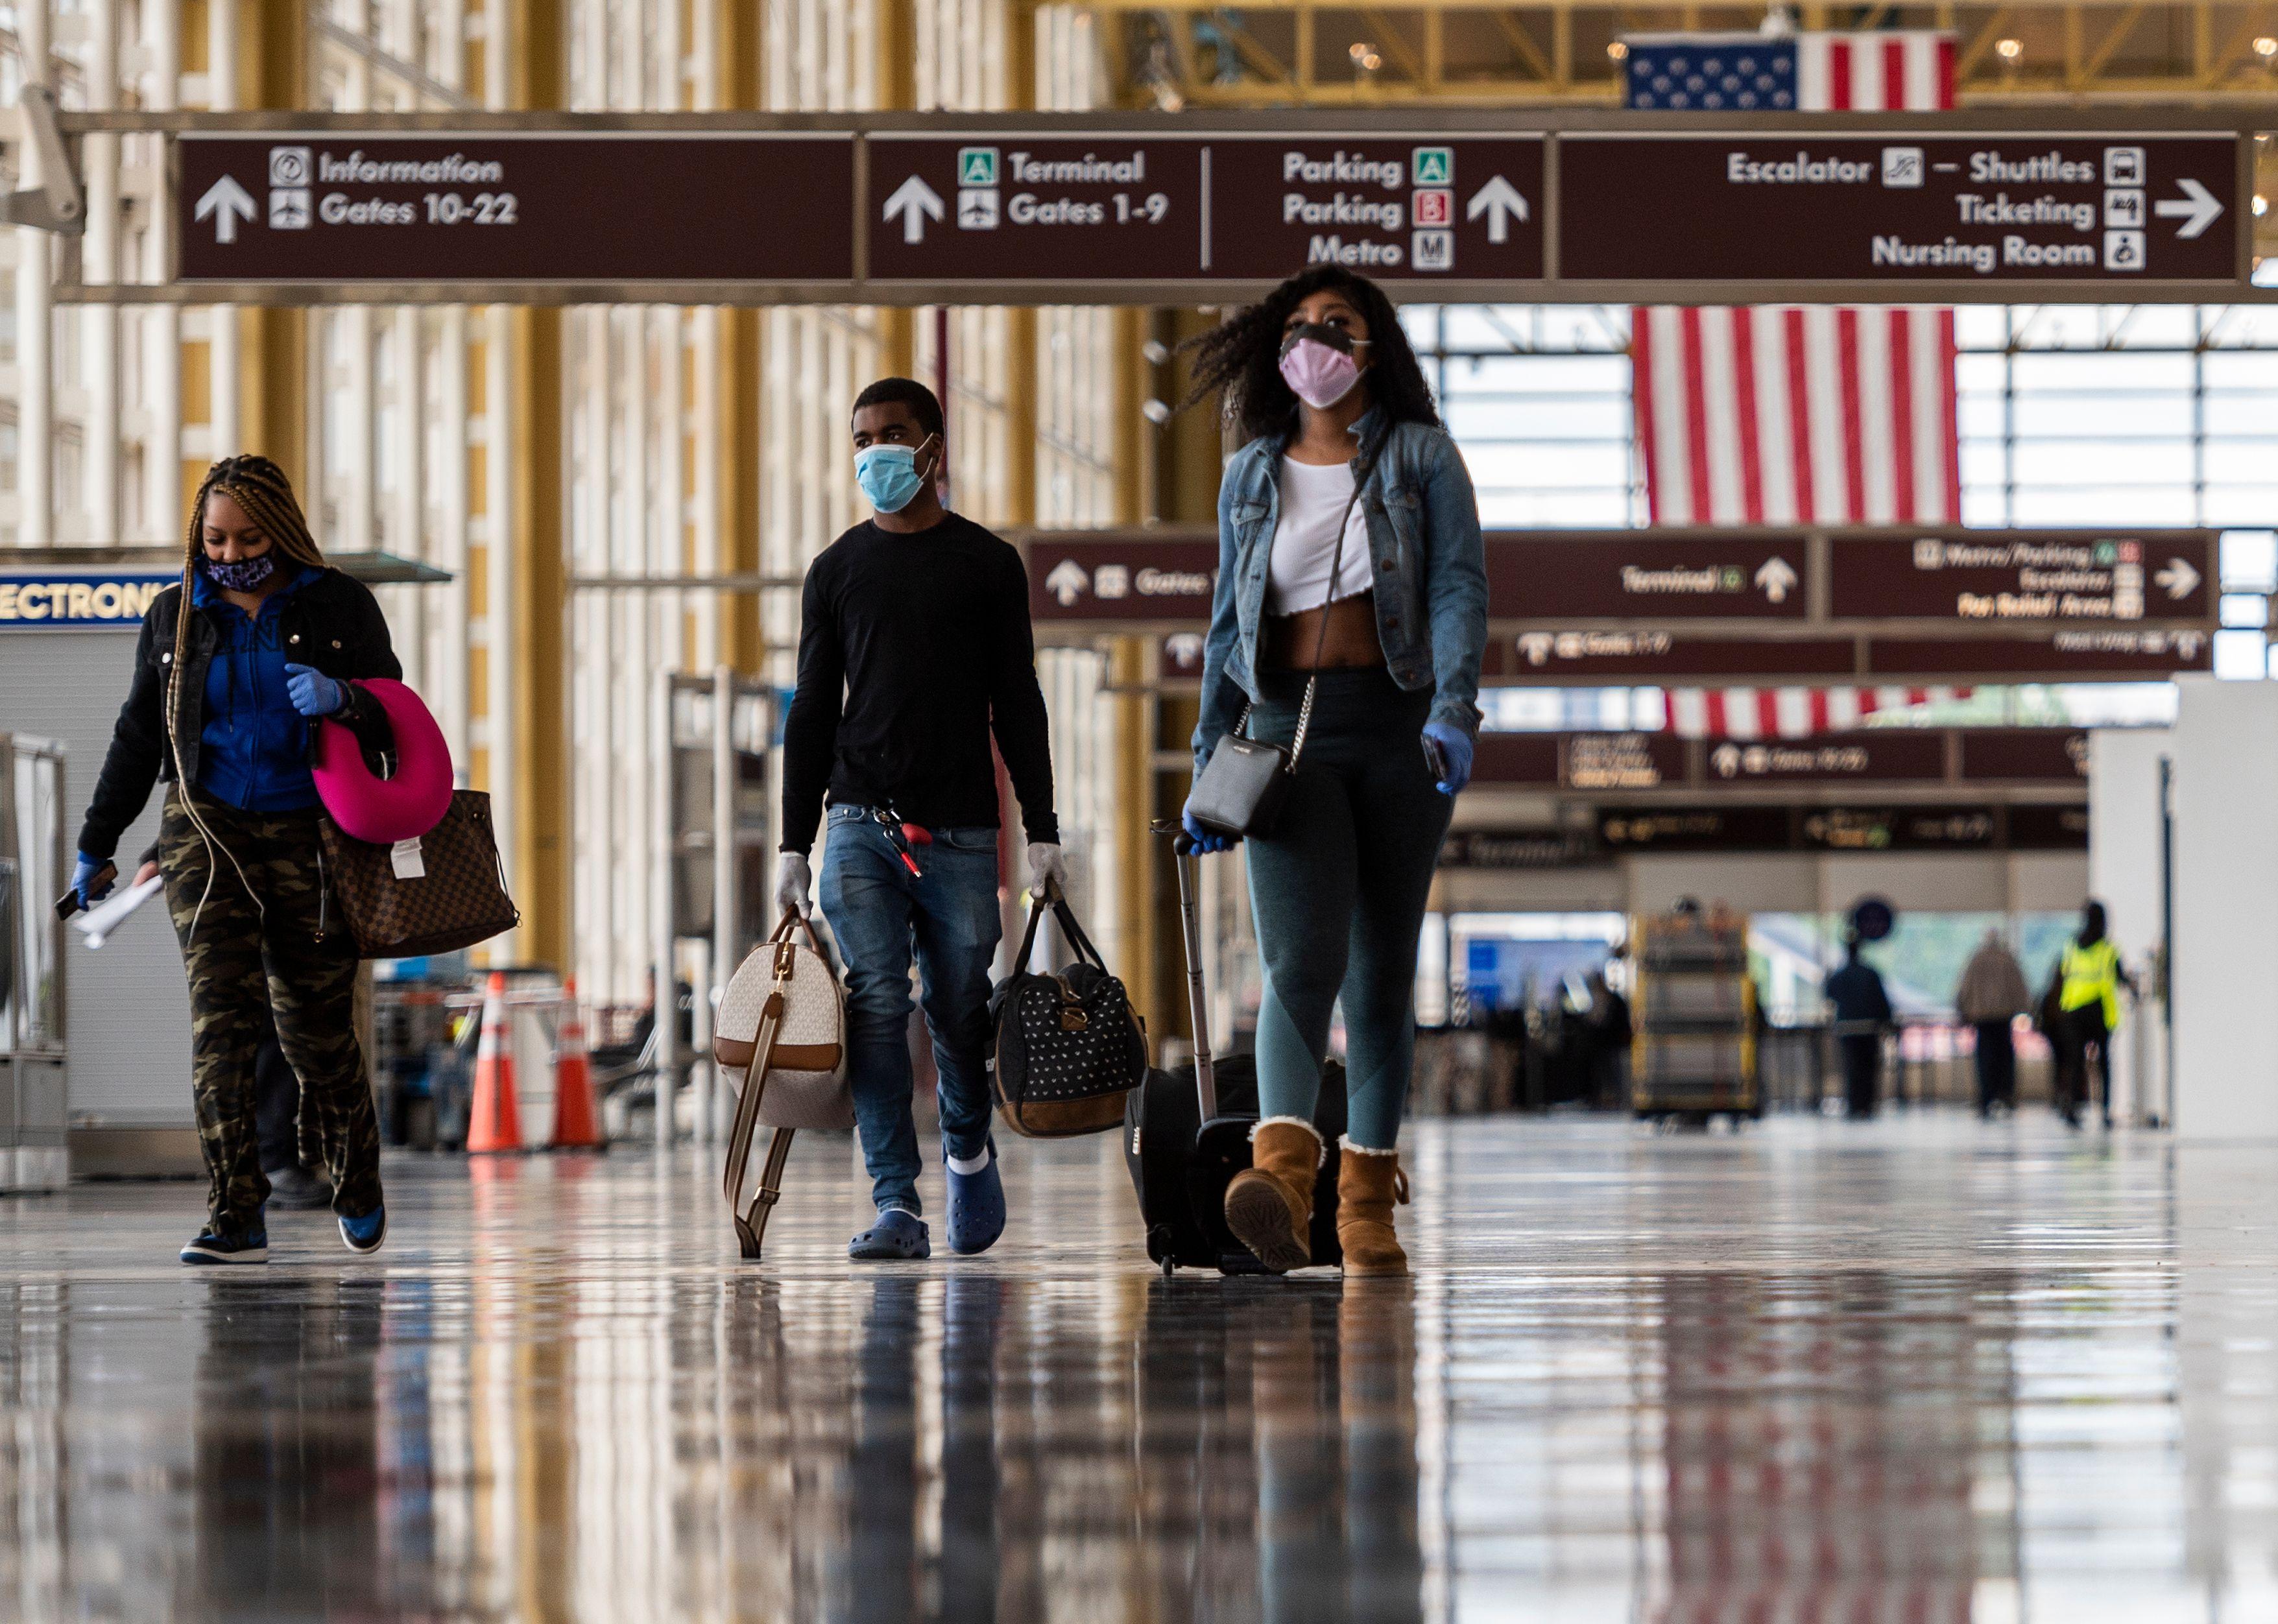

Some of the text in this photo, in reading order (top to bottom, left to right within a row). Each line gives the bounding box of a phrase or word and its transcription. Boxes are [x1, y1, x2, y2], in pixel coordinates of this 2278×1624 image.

[319, 150, 503, 183] Information
[965, 150, 1145, 182] A Terminal
[1283, 150, 1446, 189] Parking A
[1727, 150, 1872, 182] Escalator
[1969, 150, 2094, 182] Shuttles
[318, 192, 518, 224] Gates 10-22
[1007, 192, 1168, 224] Gates 1-9
[1283, 191, 1403, 231] Parking
[1954, 192, 2095, 231] Ticketing
[1307, 234, 1403, 265] Metro
[1871, 234, 2095, 272] Nursing Room
